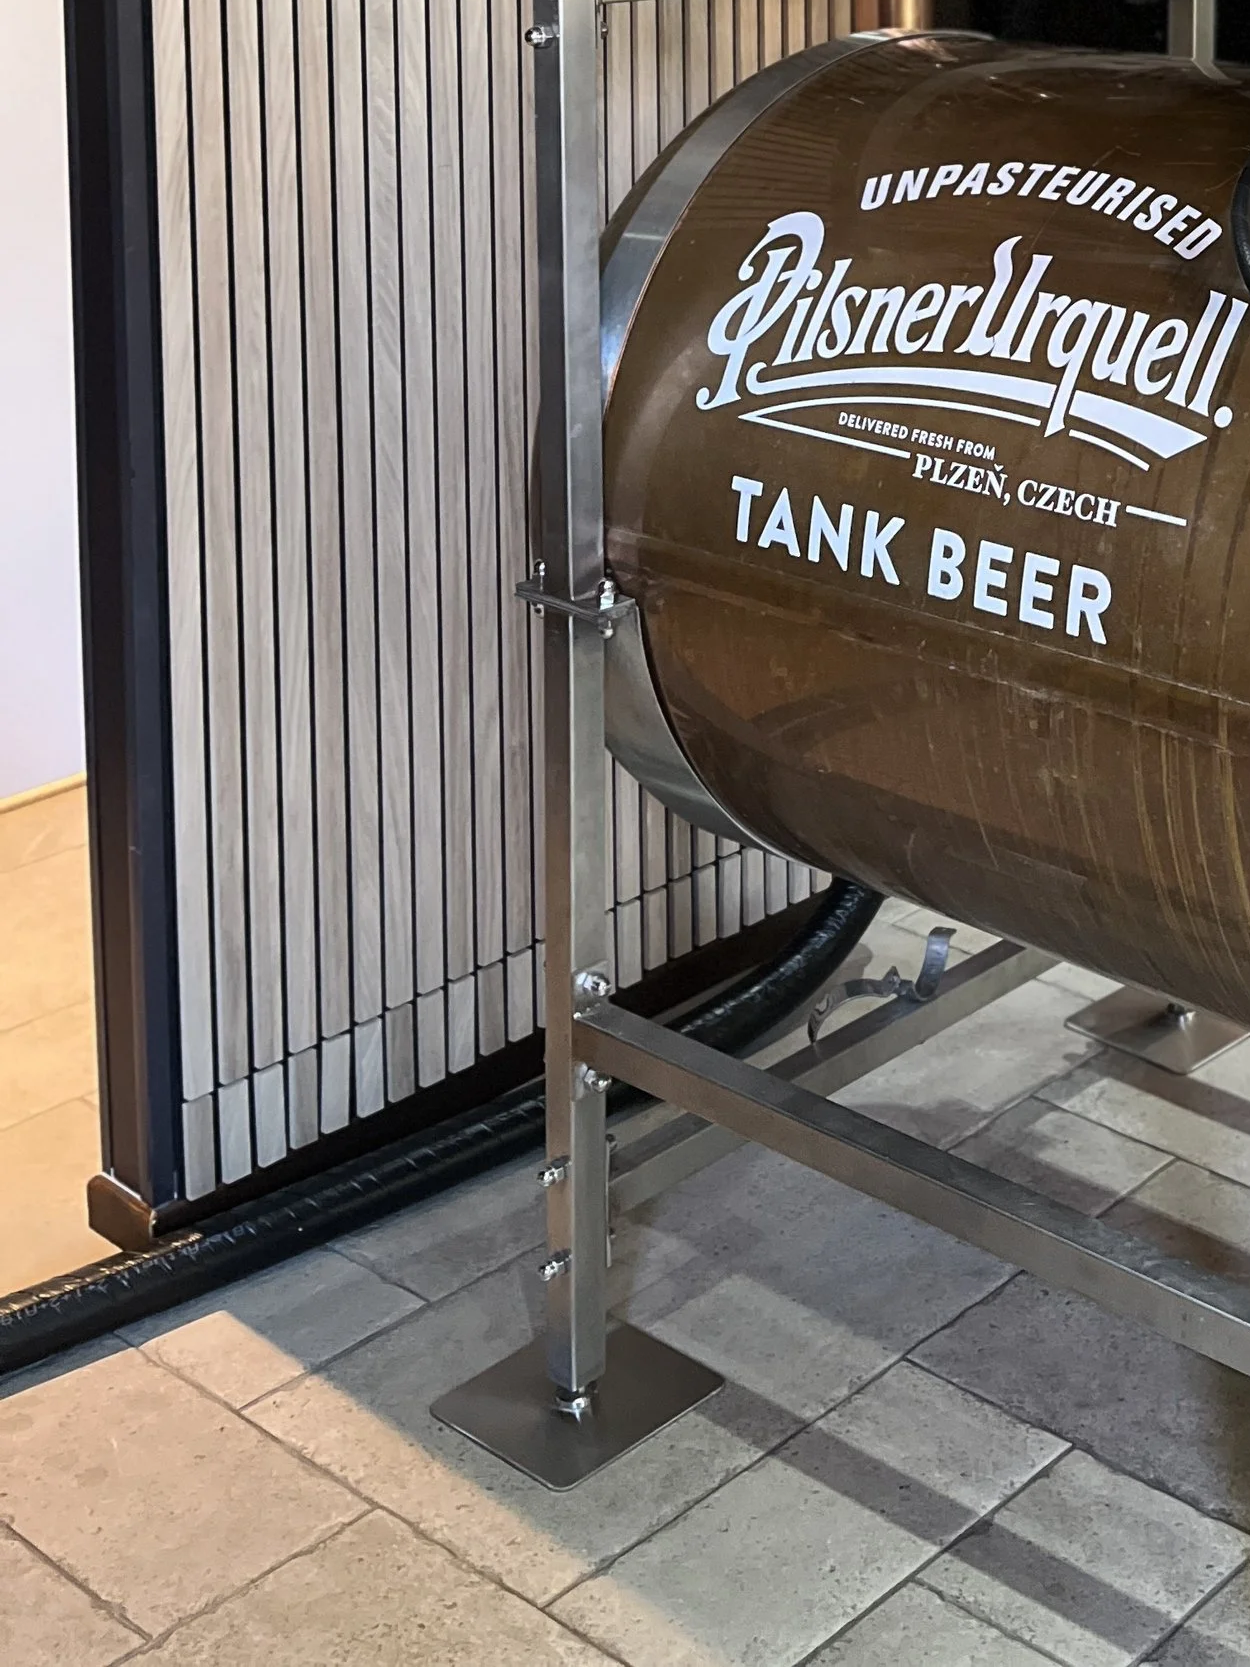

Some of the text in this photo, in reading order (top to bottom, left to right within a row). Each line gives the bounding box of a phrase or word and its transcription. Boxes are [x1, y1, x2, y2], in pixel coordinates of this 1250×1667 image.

[859, 161, 1224, 260] UNPASTEURISED
[695, 211, 989, 410] Pilsner
[838, 411, 996, 461] DELIVERED FRESH FROM
[1017, 479, 1121, 528] CZECH
[731, 475, 1113, 646] TANK BEER
